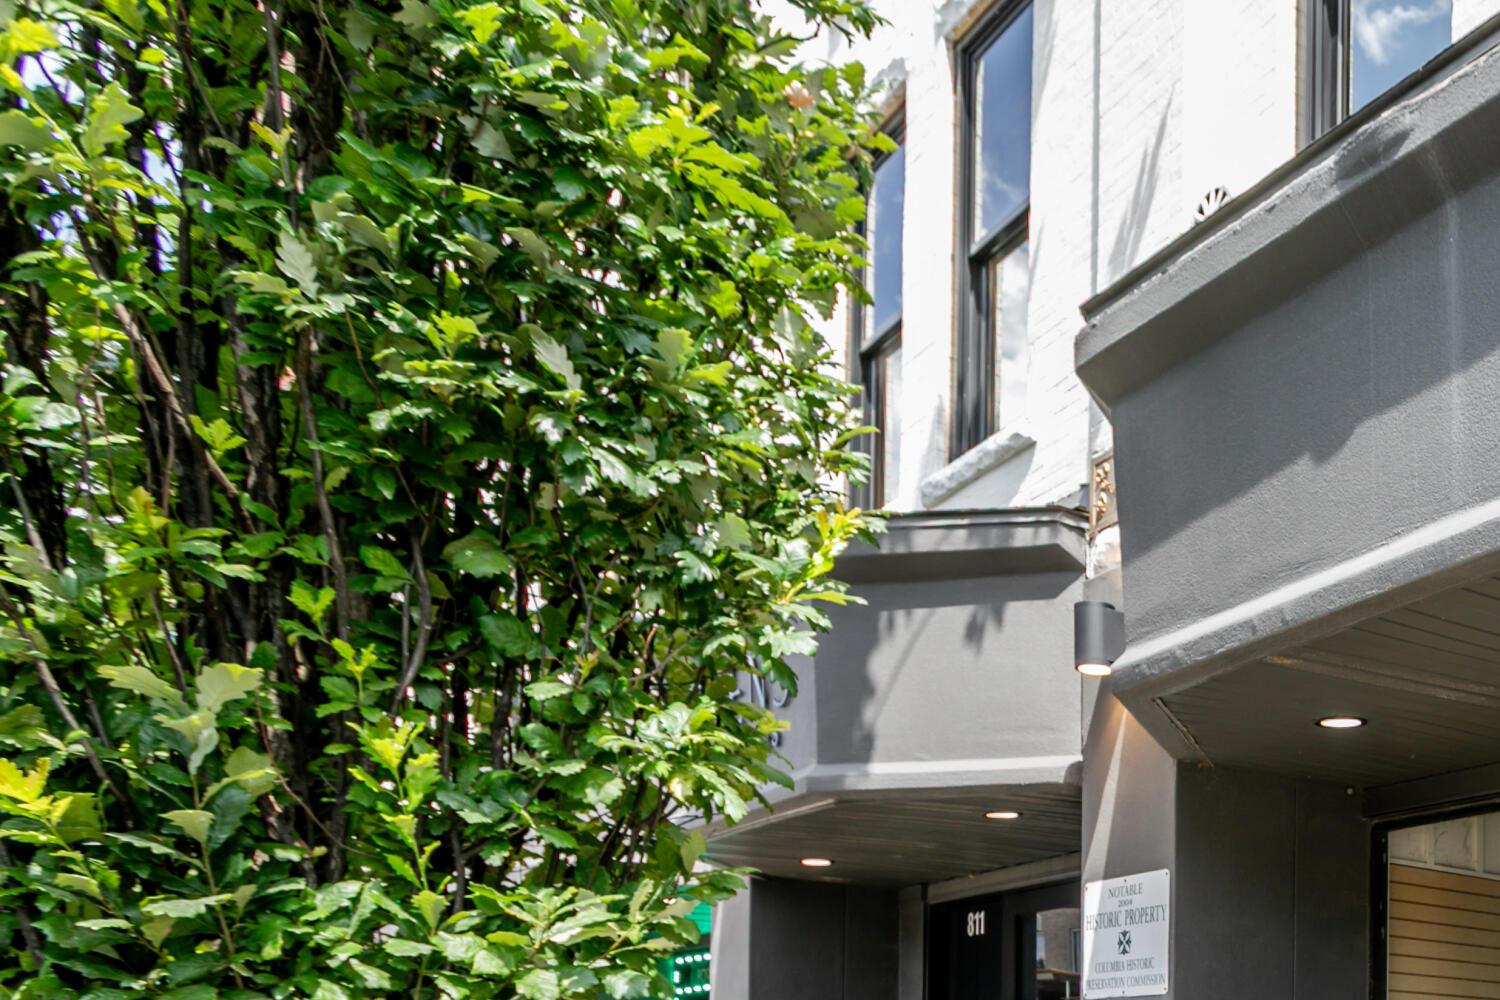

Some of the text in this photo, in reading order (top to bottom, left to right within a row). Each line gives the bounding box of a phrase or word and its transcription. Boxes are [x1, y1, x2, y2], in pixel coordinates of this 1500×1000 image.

[1108, 883, 1143, 899] NOTABLE
[967, 910, 985, 937] 811
[1086, 904, 1167, 931] HISTORIC PROPERTY
[1094, 957, 1155, 974] COLUMBIA HISTORIC
